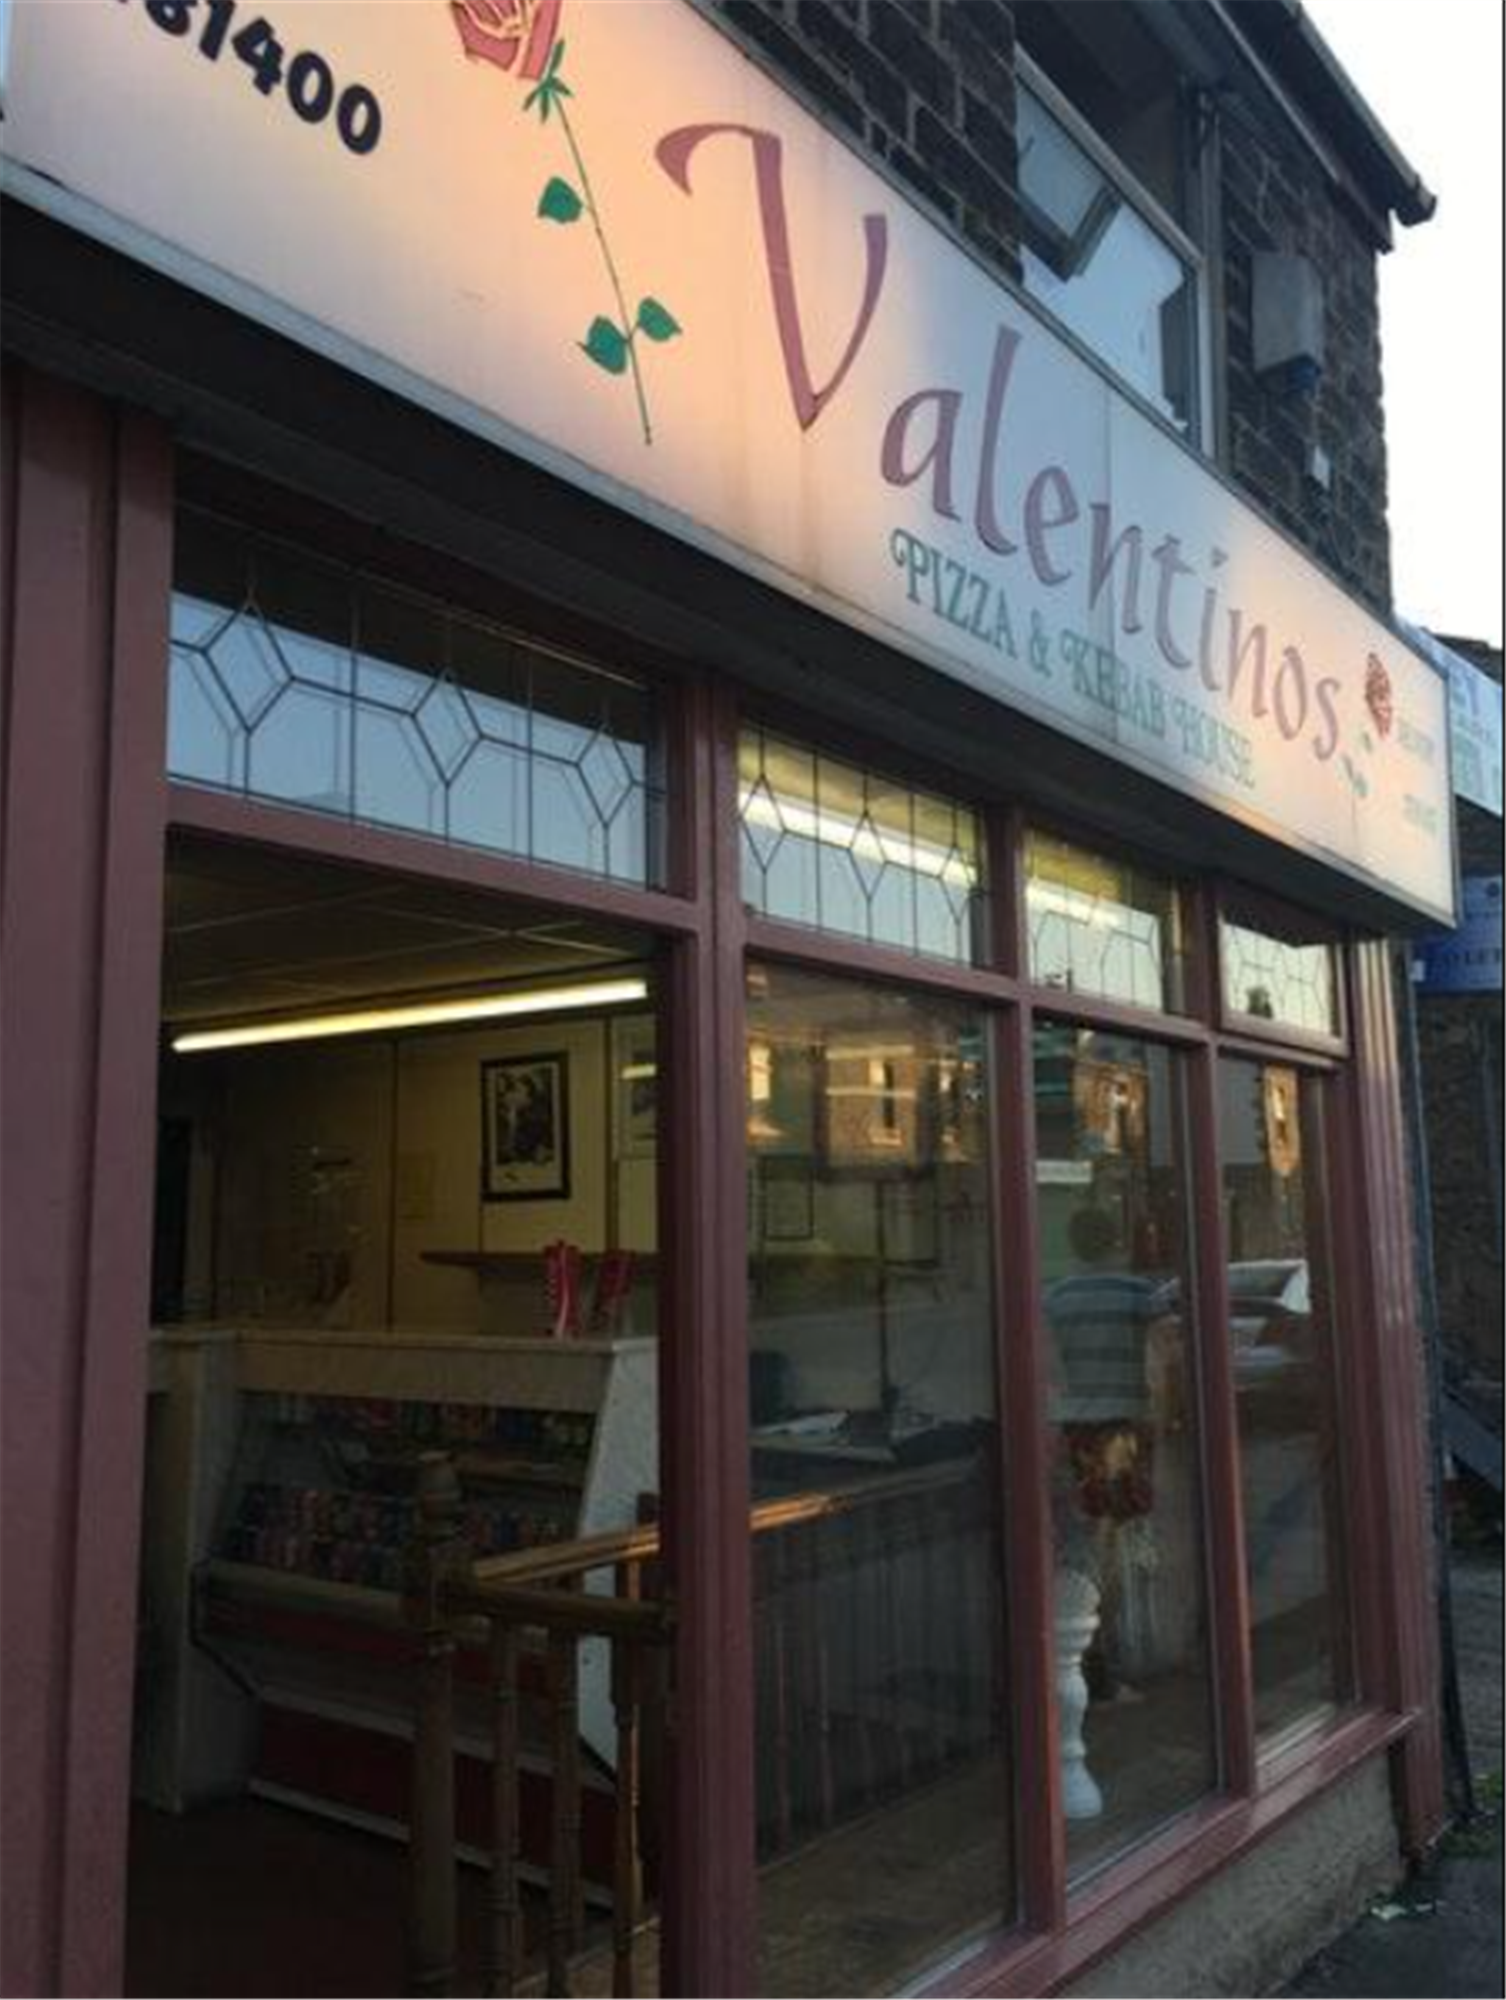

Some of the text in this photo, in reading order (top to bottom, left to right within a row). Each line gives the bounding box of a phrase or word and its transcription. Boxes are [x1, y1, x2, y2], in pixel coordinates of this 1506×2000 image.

[655, 122, 1342, 762] Valentinos
[889, 528, 1255, 790] PIZZA & KEBAB HOUSE
